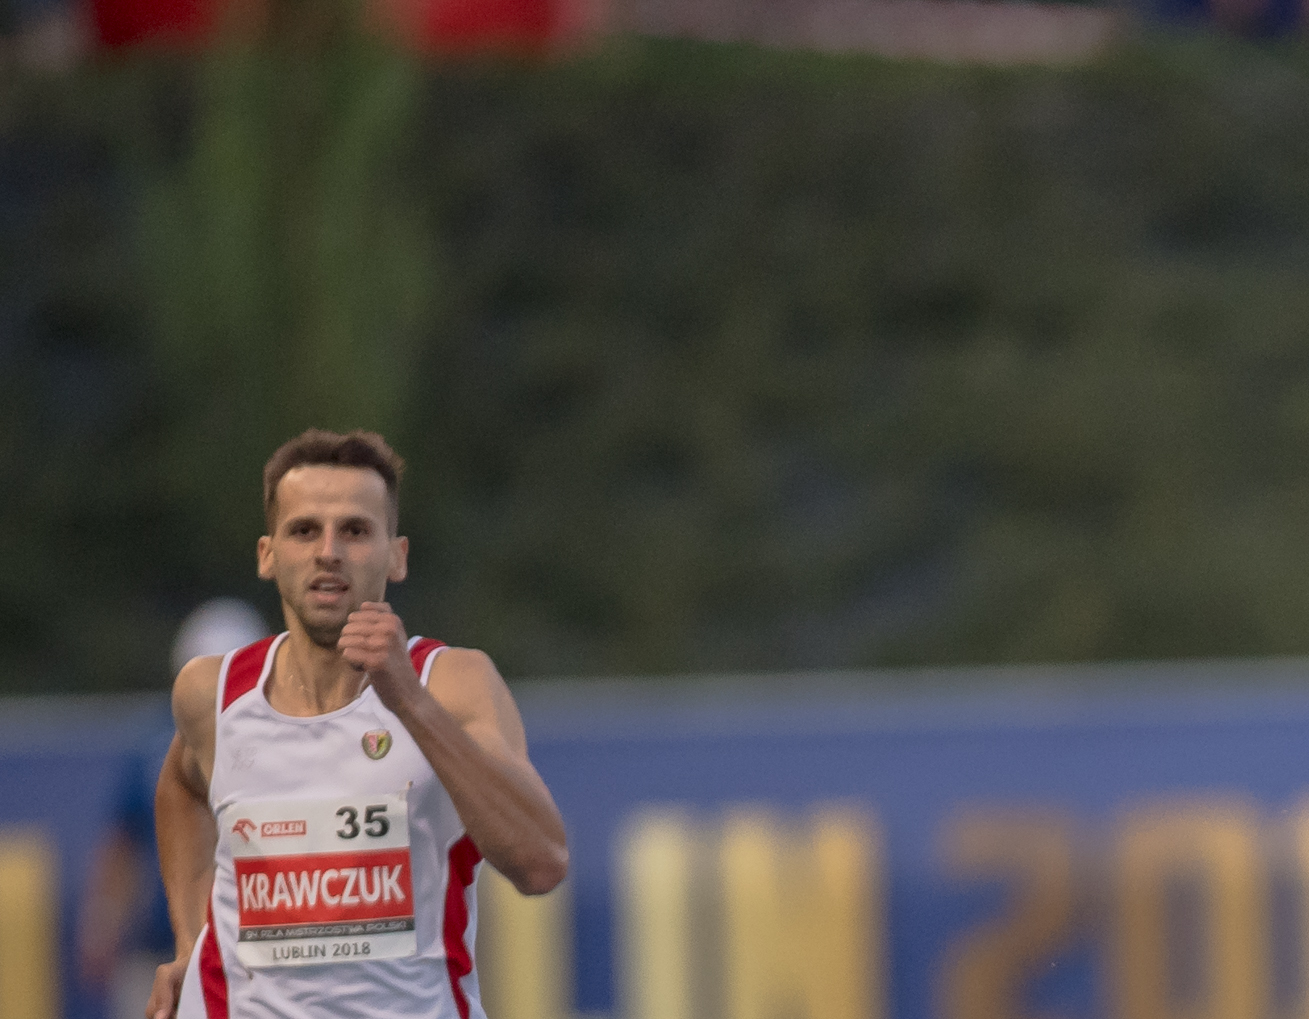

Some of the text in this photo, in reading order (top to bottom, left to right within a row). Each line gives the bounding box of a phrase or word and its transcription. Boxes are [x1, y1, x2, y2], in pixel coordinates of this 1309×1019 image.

[263, 822, 304, 835] ORLEN
[336, 804, 390, 839] 35
[241, 864, 406, 911] KRAWCZUK
[273, 941, 371, 960] LUBLIN 2018
